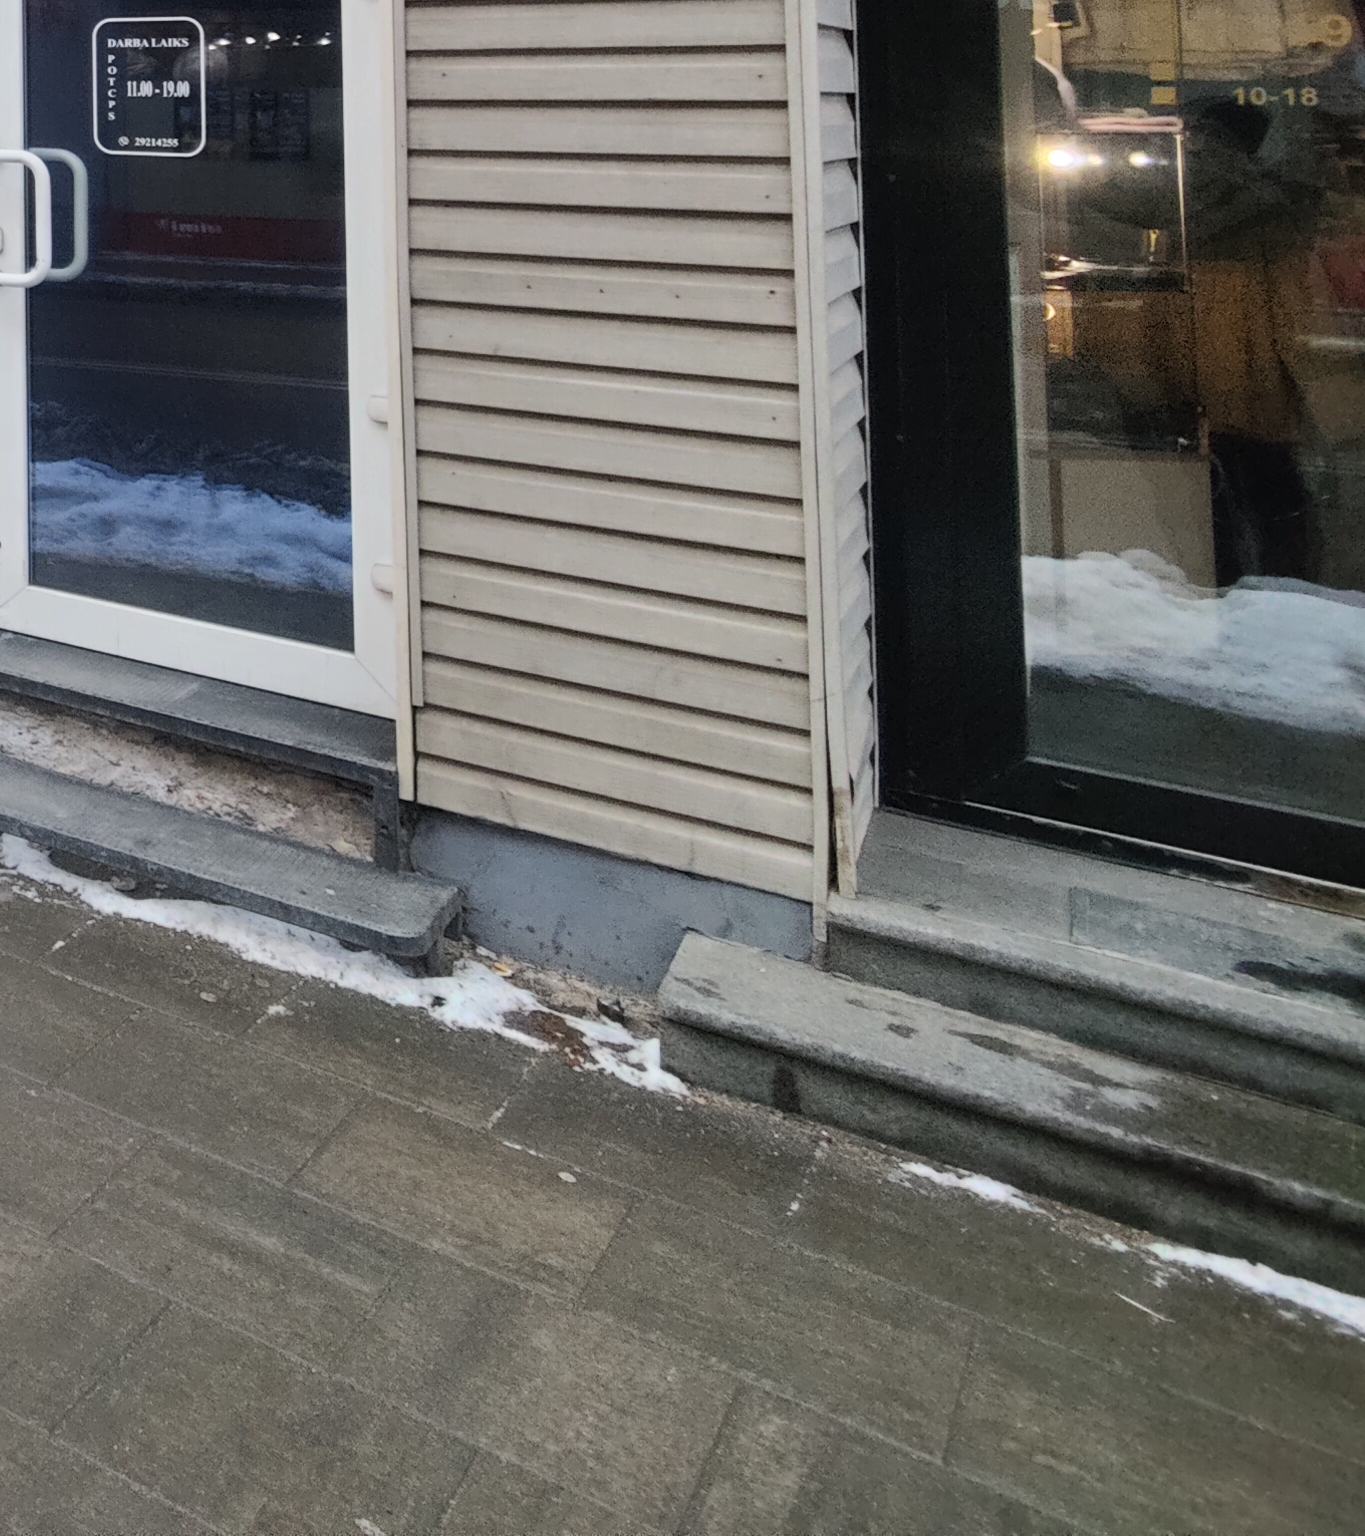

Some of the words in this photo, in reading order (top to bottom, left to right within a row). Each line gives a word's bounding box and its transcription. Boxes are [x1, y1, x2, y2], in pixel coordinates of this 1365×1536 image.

[107, 38, 149, 49] DARBA
[151, 37, 189, 48] LAIKS
[127, 80, 153, 98] 11.00
[162, 80, 190, 98] 19.00
[1232, 86, 1319, 107] 10-18
[134, 137, 180, 148] 29214255
